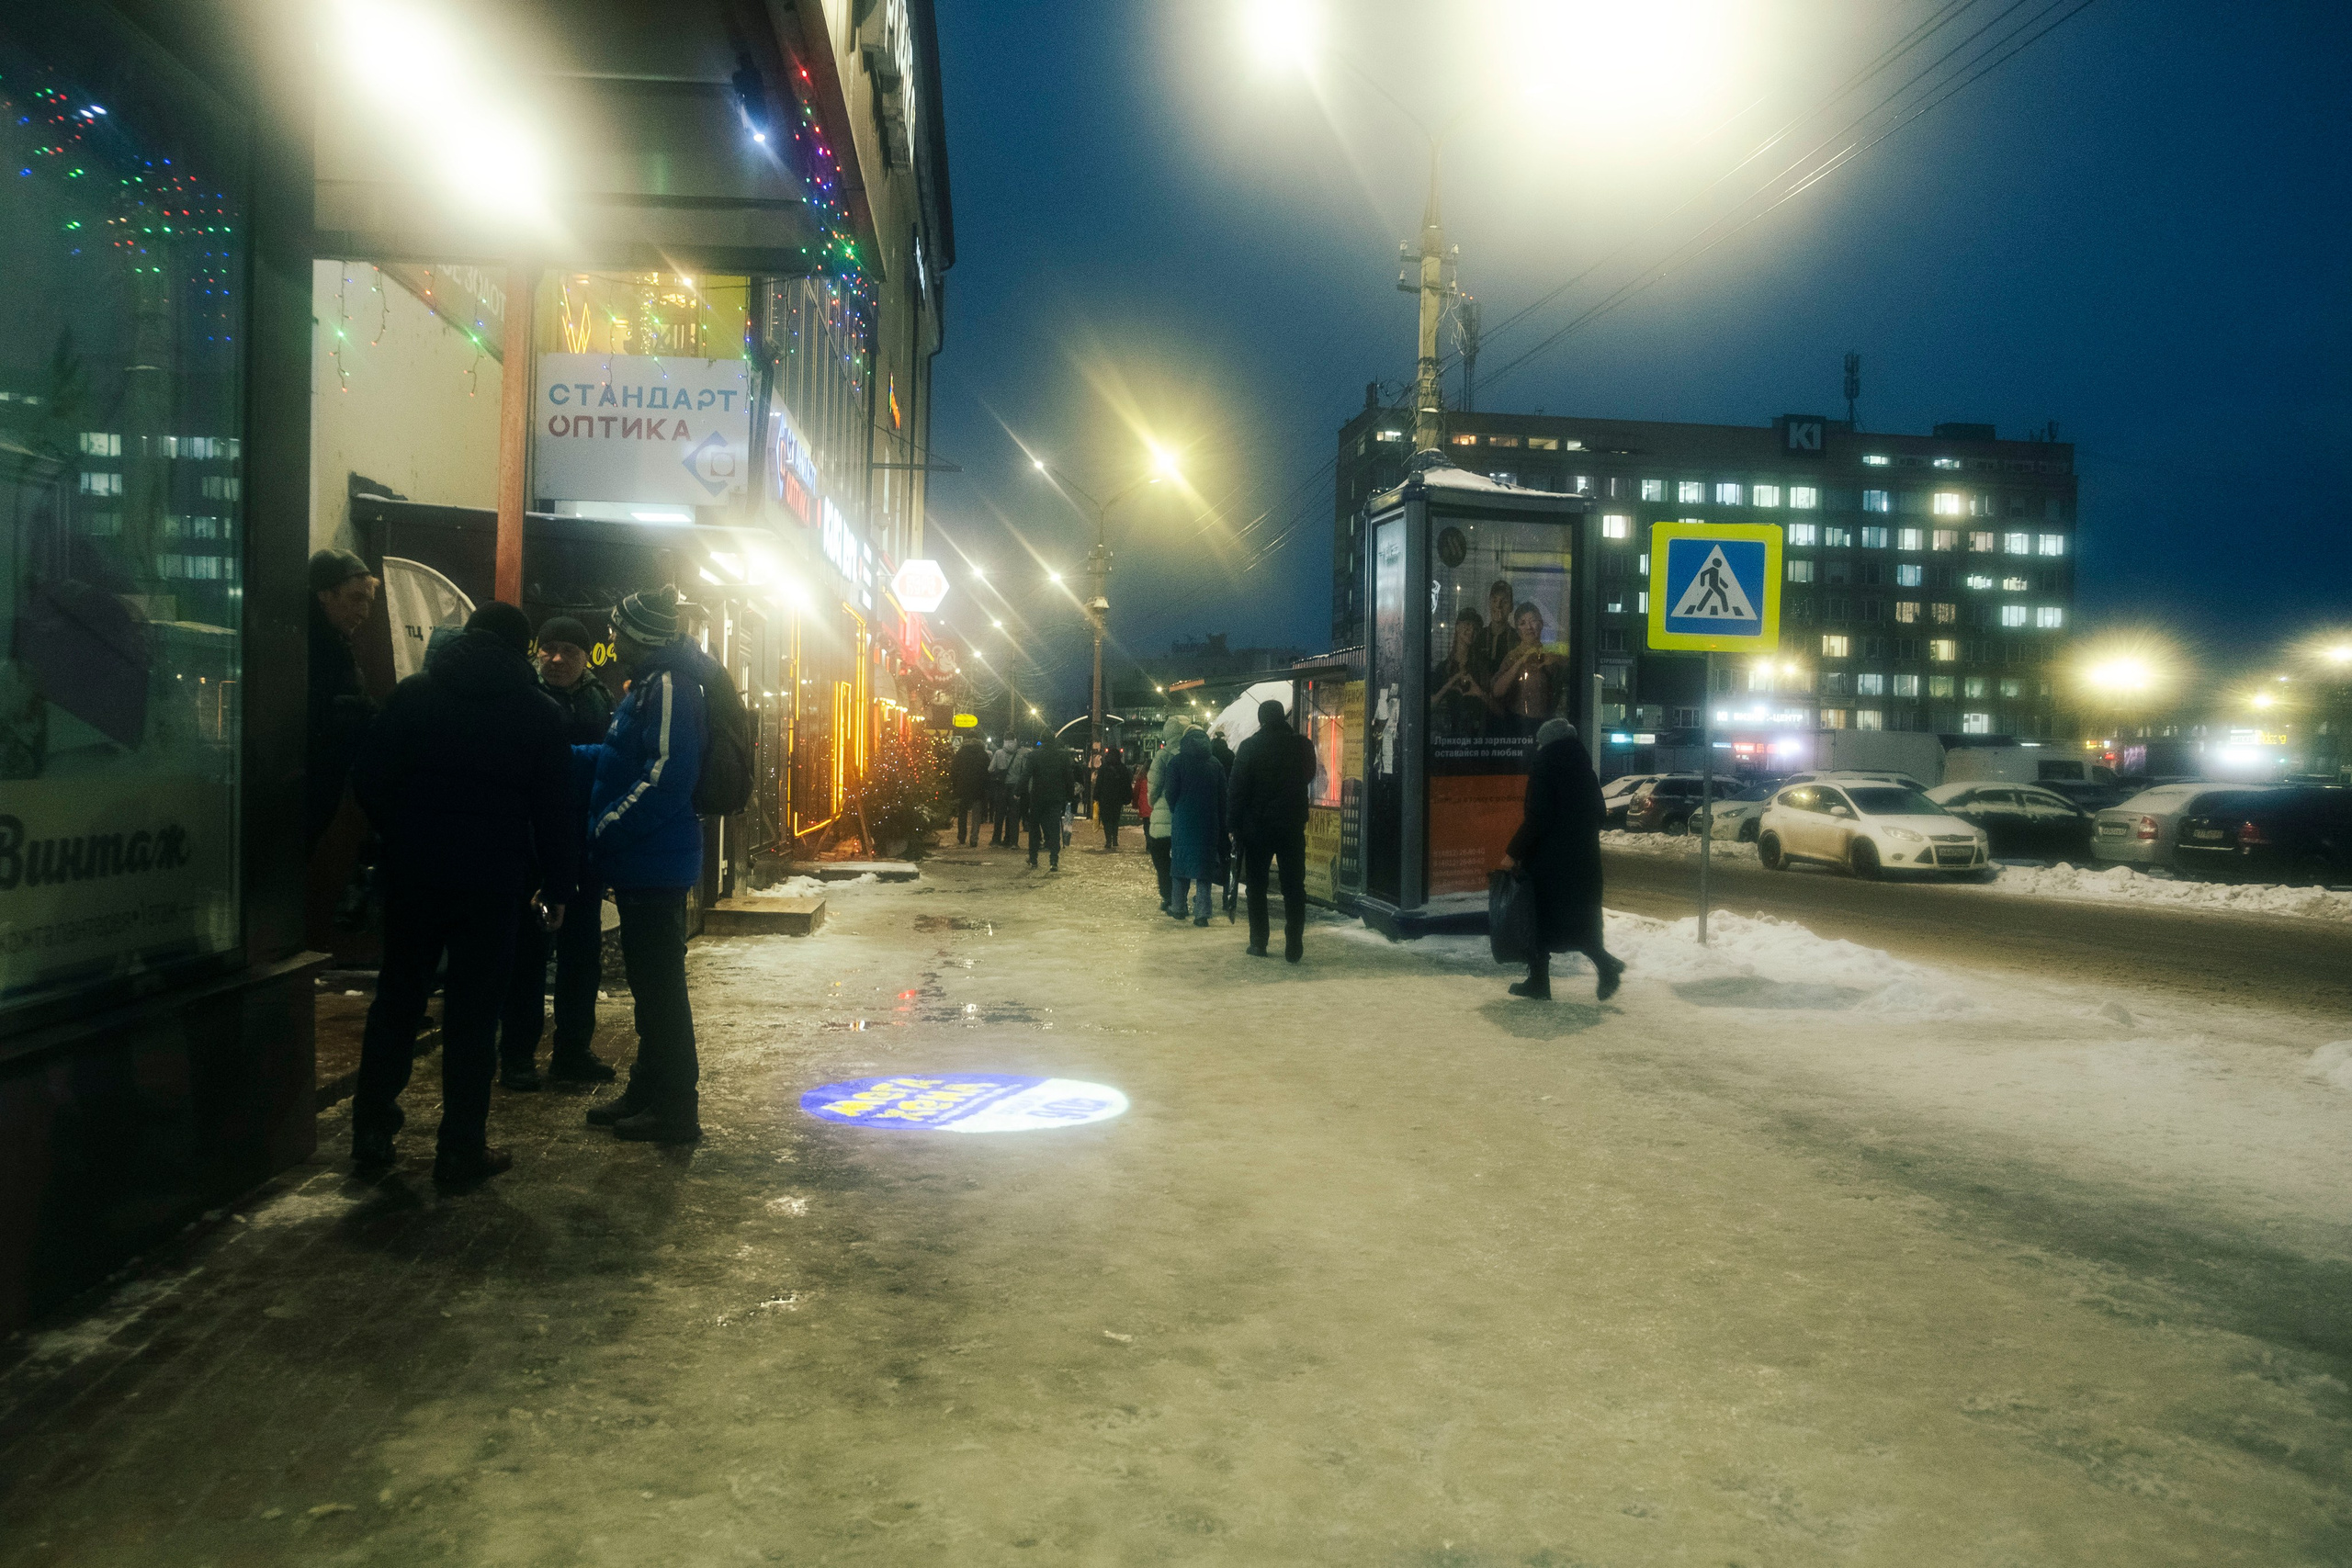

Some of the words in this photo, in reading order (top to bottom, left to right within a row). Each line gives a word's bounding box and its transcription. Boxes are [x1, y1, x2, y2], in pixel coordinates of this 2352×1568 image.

[548, 383, 738, 412] СТАНДАРТ
[548, 414, 692, 441] ОПТИКА
[405, 625, 424, 641] ТЦ
[1434, 735, 1472, 746] Приходи
[1473, 737, 1483, 745] за
[1485, 735, 1534, 746] зарплатой
[1434, 748, 1479, 758] оставайся
[1491, 748, 1523, 757] любви
[0, 814, 191, 891] Винтаж
